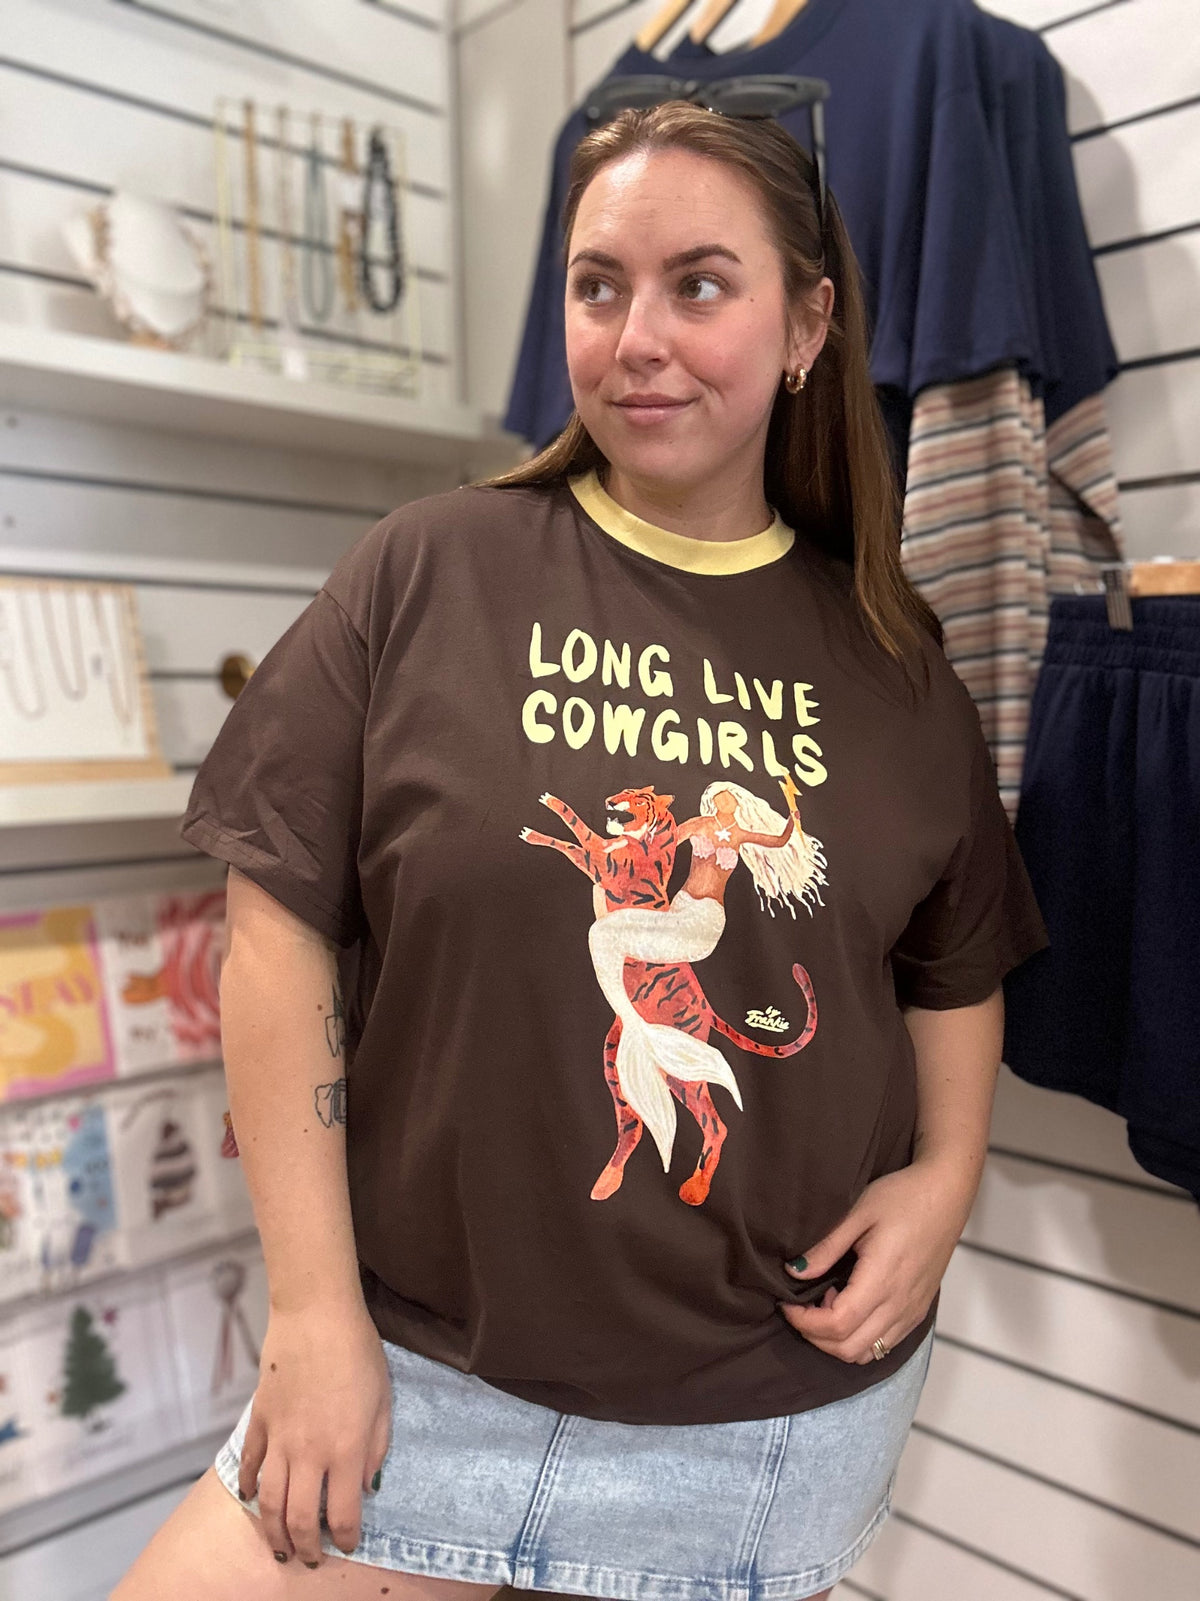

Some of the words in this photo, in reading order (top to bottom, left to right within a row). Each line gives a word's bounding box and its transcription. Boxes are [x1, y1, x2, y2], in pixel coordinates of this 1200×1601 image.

[529, 622, 673, 697] LONG
[704, 658, 821, 727] LIVE
[522, 689, 828, 786] COWGIRLS
